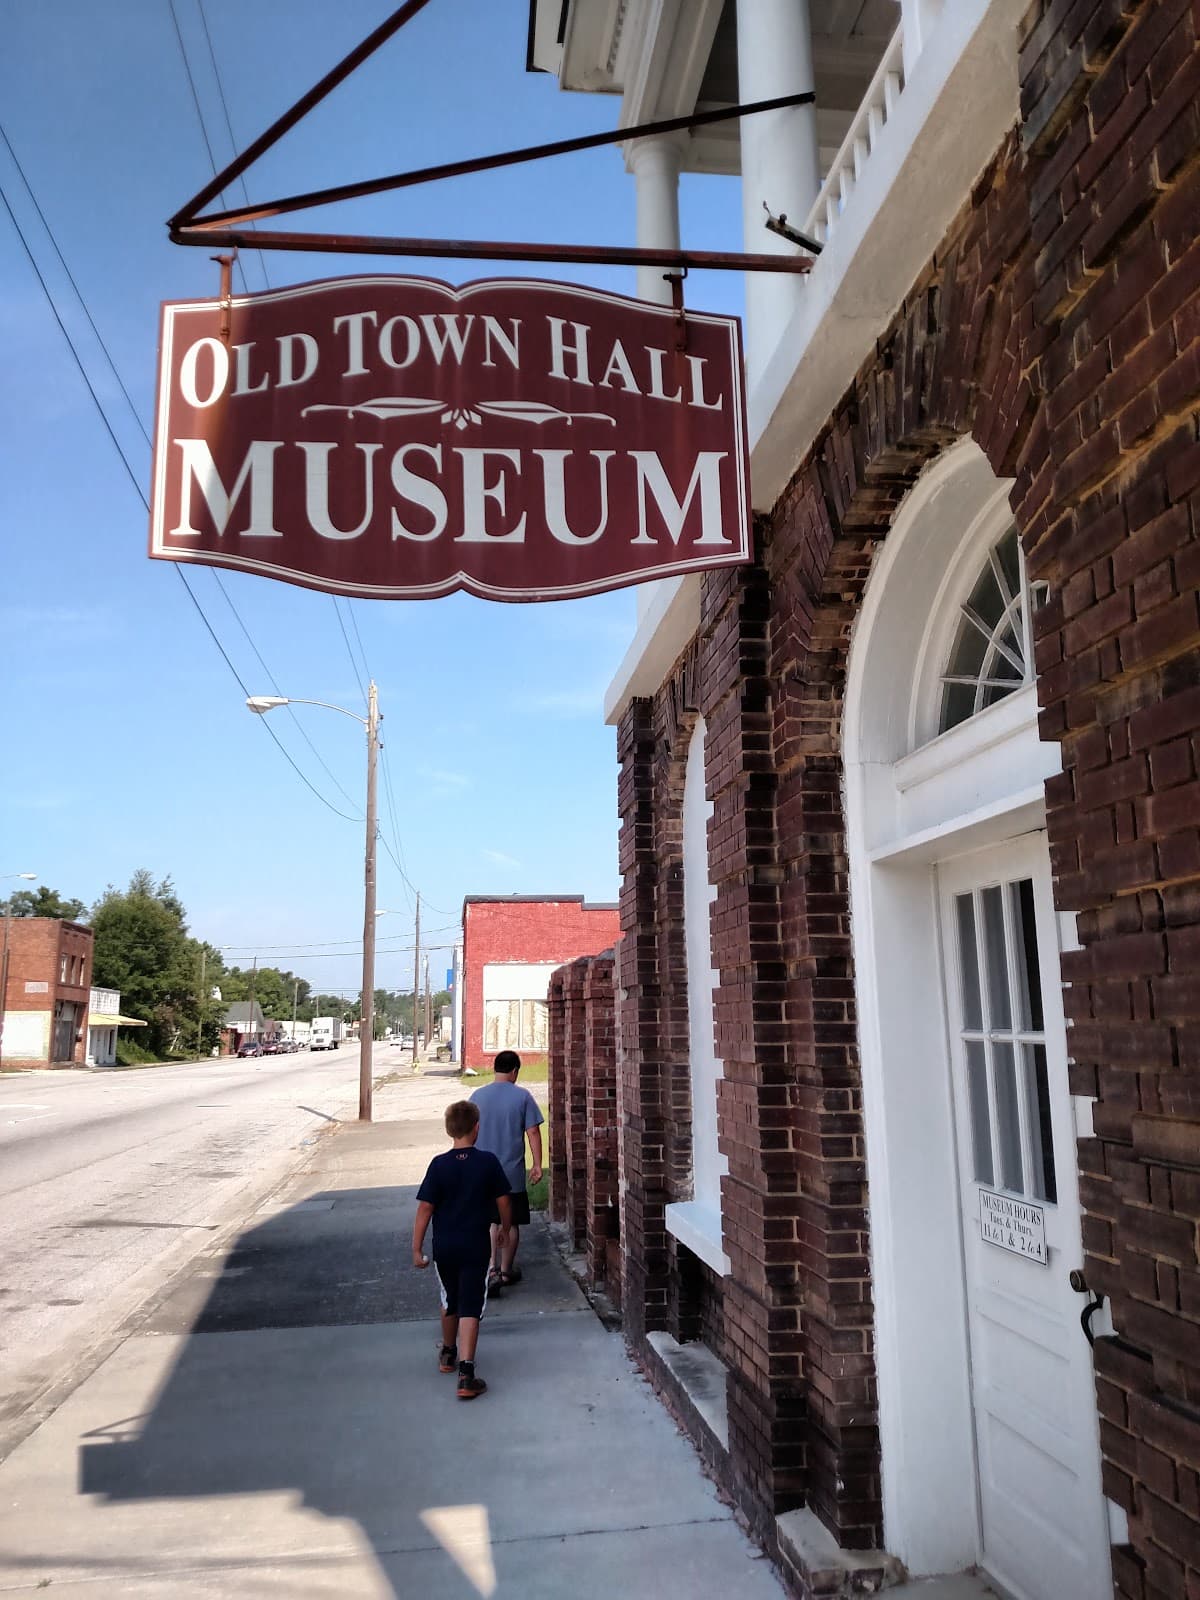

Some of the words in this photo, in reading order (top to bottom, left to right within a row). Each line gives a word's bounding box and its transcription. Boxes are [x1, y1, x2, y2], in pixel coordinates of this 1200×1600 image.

[180, 332, 319, 409] OLD
[333, 310, 521, 377] TOWN
[545, 315, 722, 411] HALL
[169, 437, 733, 546] MUSEUM
[982, 1193, 1013, 1217] MUSEUM
[1014, 1204, 1041, 1226] HOURS
[1005, 1217, 1011, 1229] &
[1008, 1232, 1015, 1247] &
[1020, 1236, 1026, 1250] 2
[1036, 1243, 1042, 1256] 4
